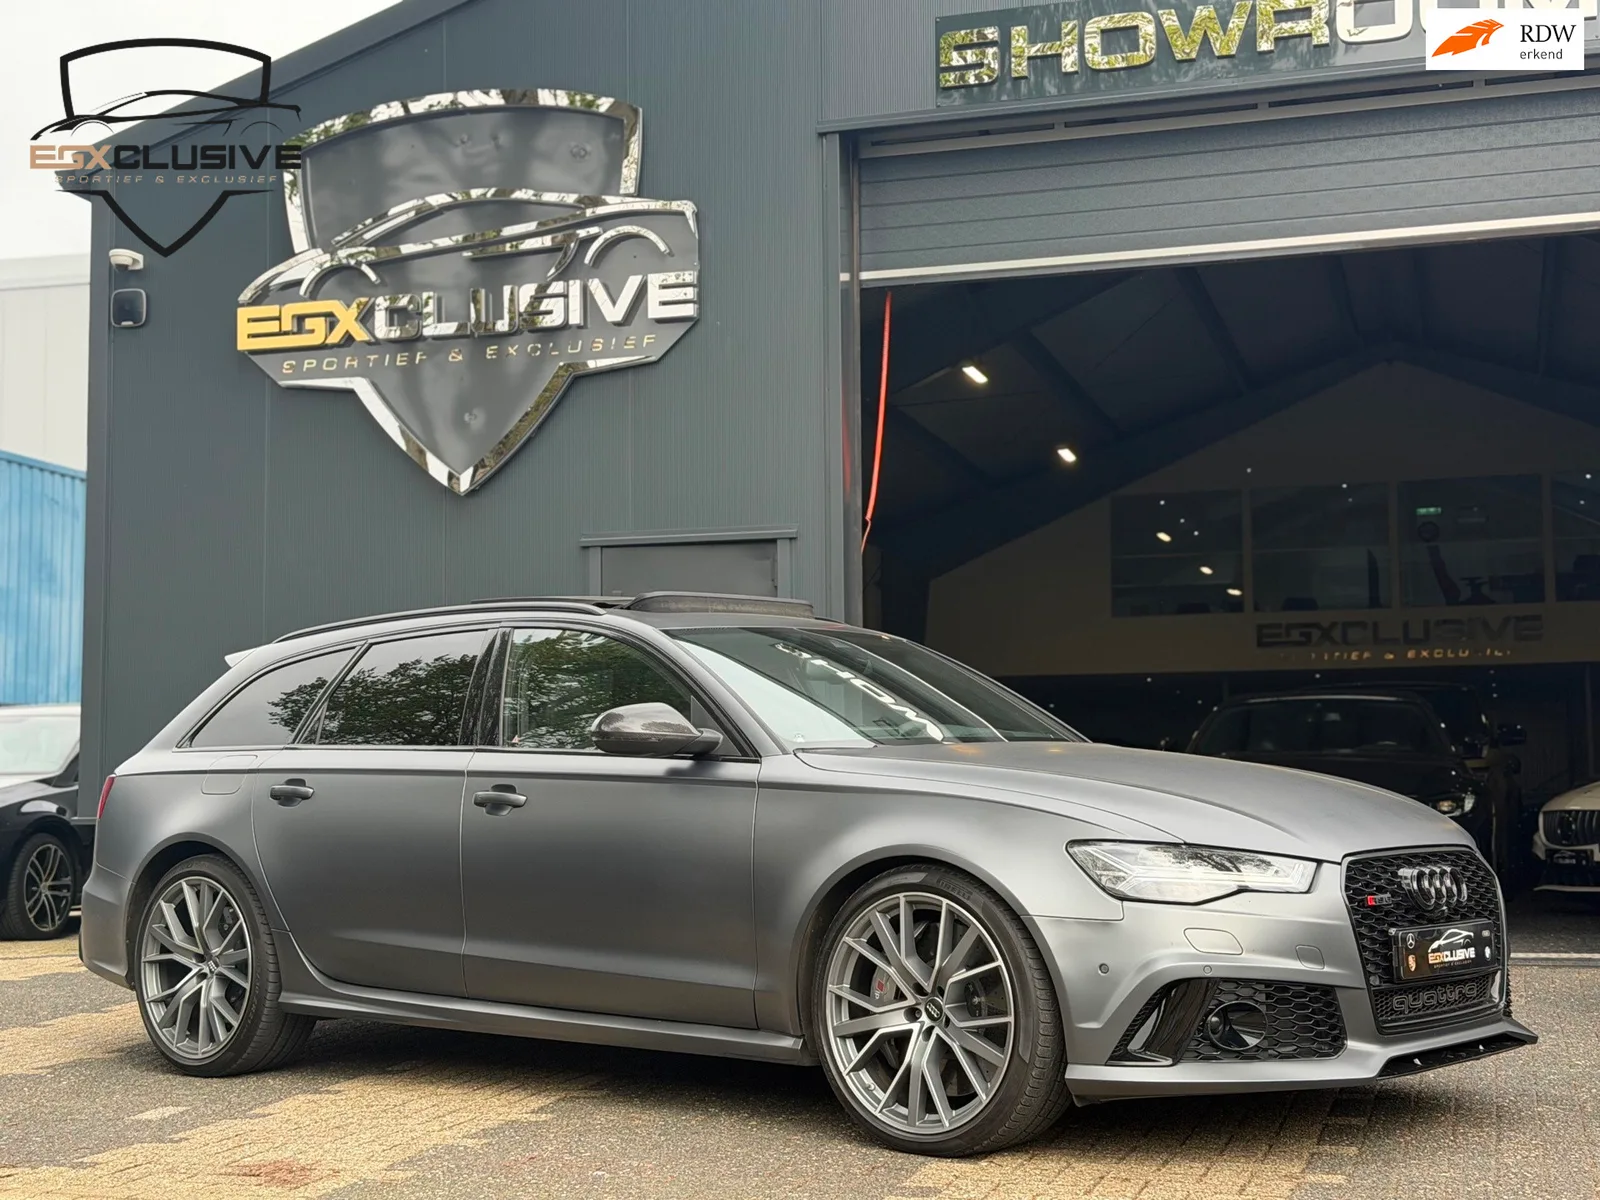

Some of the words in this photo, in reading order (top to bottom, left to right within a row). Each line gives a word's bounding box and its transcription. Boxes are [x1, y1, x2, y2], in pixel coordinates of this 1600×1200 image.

[939, 0, 1598, 88] SHOWRO
[236, 269, 698, 352] EGXCLUSIVE
[282, 350, 428, 374] SPORTIEF
[448, 349, 464, 363] &
[486, 333, 657, 360] EXCLUSIEF
[1255, 613, 1544, 648] EGXCLUSIVE
[1392, 981, 1478, 1015] quattro
